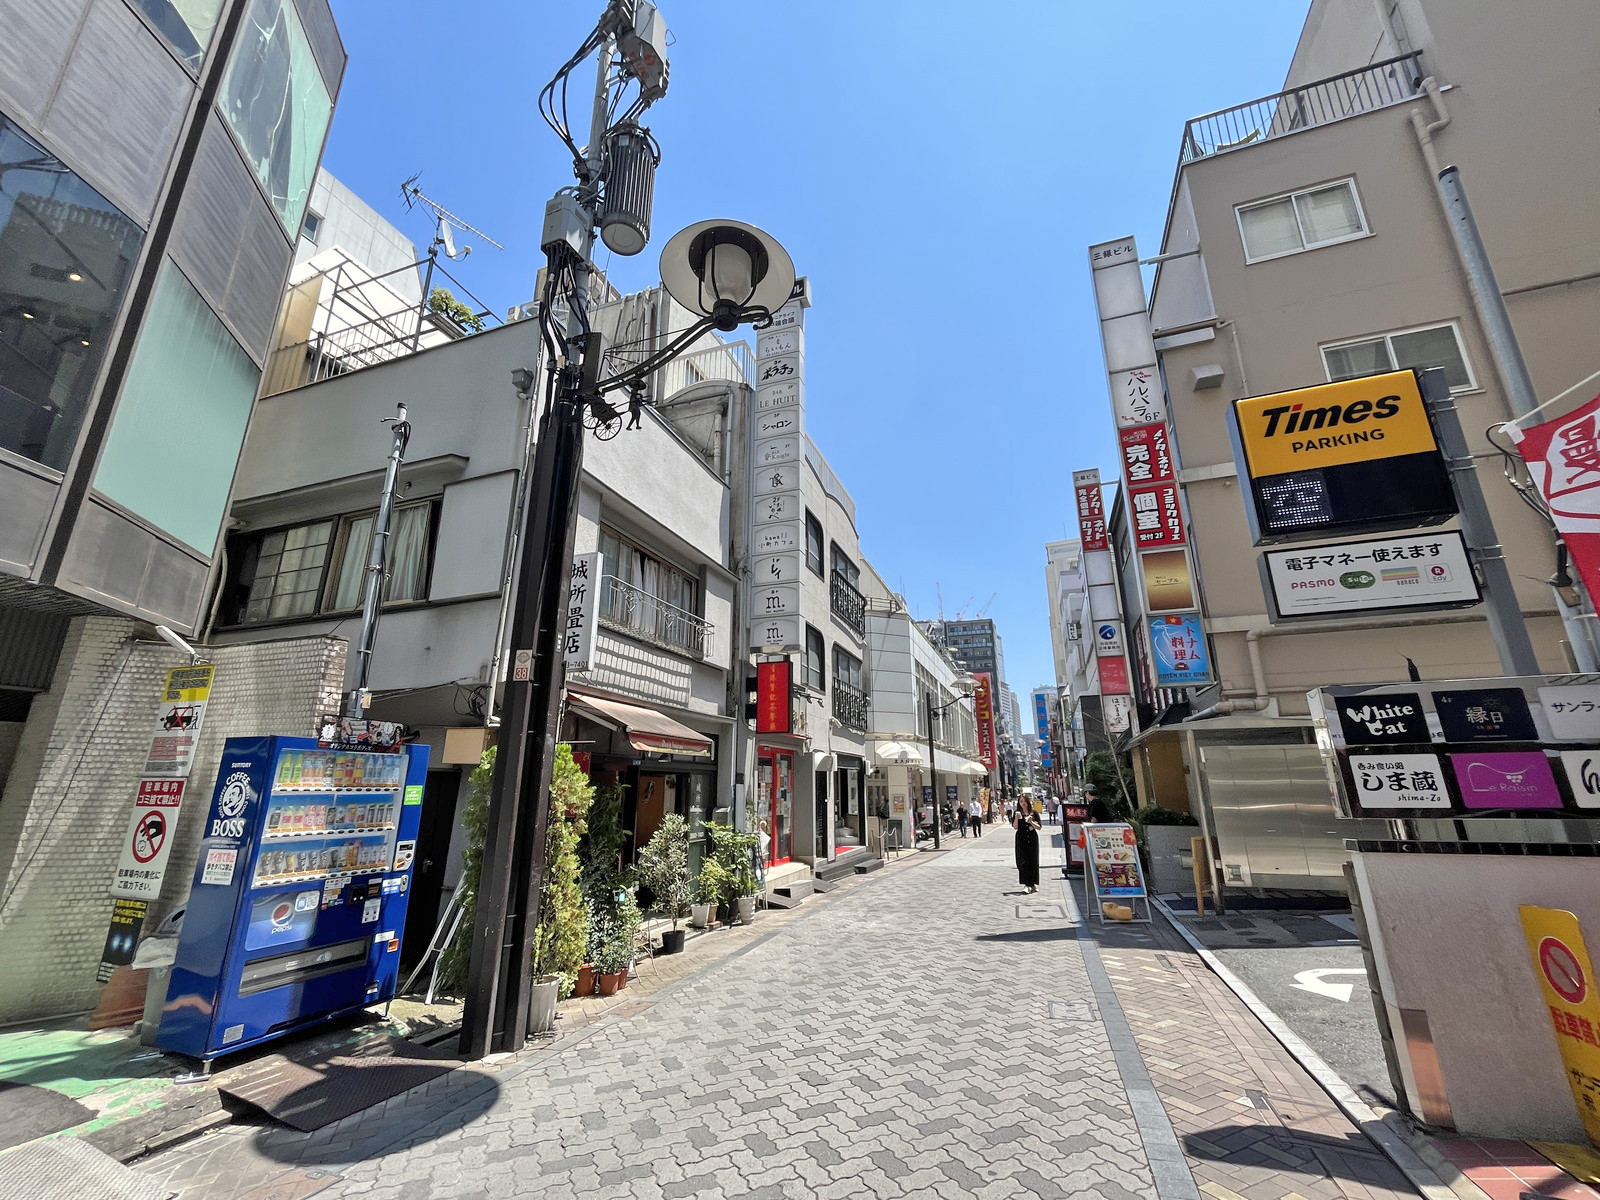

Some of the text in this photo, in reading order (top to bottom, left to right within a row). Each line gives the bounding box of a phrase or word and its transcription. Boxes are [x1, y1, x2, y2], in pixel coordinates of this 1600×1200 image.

[760, 395, 795, 408] LE HUIT
[1128, 375, 1151, 416] バルバラ
[762, 420, 792, 432] シャロン
[1145, 411, 1160, 422] 6F
[1262, 395, 1401, 438] Times
[1292, 428, 1385, 453] PARKING
[1126, 444, 1153, 481] 完全
[1153, 429, 1171, 477] インターネット
[1133, 492, 1162, 530] 個室
[1163, 488, 1181, 540] コミックカフェ
[1082, 521, 1092, 541] カフェ
[1285, 543, 1443, 572] 電子マネー使えます
[1291, 579, 1335, 590] PASMO
[1348, 574, 1374, 583] Suica
[1171, 637, 1187, 660] 料理
[1346, 704, 1414, 723] White
[1465, 706, 1504, 724] 縁日
[1551, 701, 1600, 713] サンラ
[1365, 720, 1408, 736] Cat
[226, 771, 251, 786] COFFEE
[1361, 771, 1438, 791] しま蔵
[1499, 783, 1538, 792] Raisin
[211, 819, 245, 837] BOSS
[271, 925, 293, 935] pepsi
